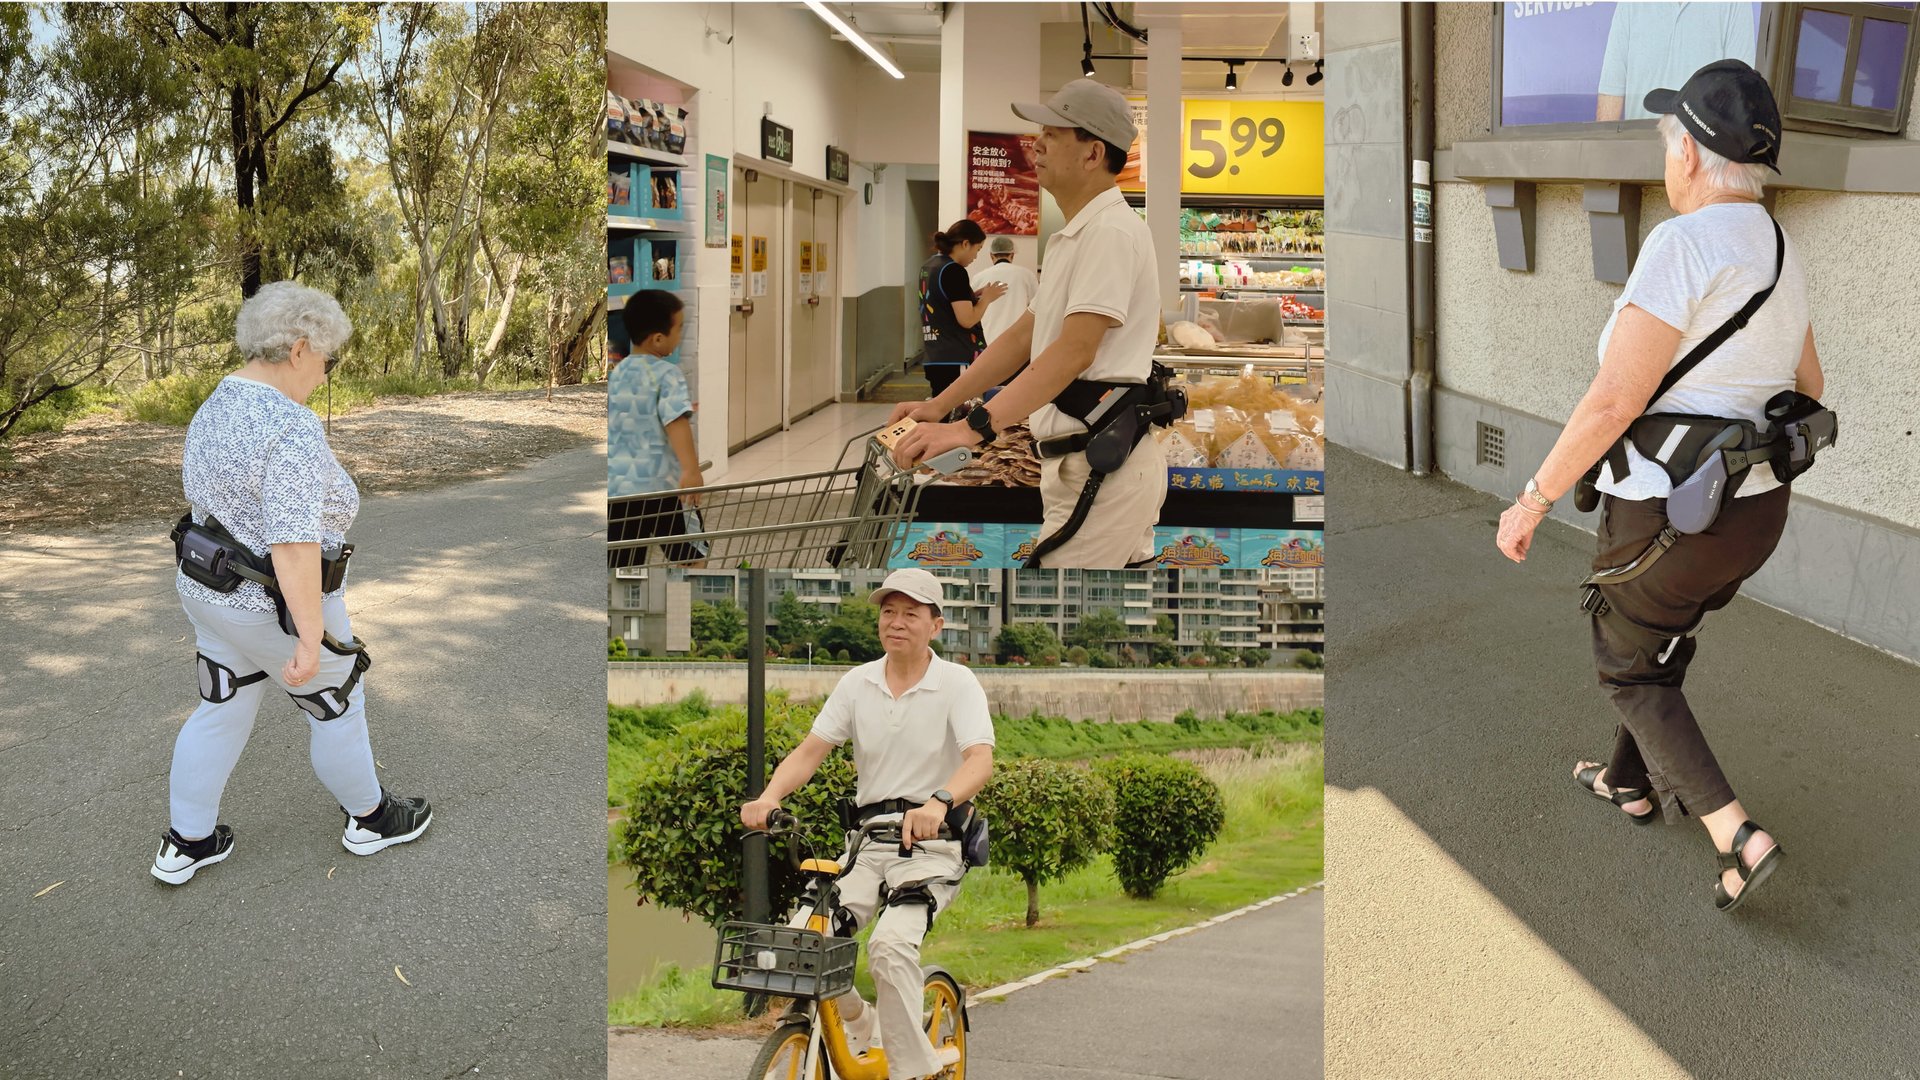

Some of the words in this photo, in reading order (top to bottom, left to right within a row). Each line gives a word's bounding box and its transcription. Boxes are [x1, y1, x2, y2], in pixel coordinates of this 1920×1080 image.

[1706, 127, 1716, 137] DAY
[972, 146, 1007, 157] 安全放心
[1188, 117, 1285, 179] 5.99
[1287, 475, 1322, 493] 欢迎
